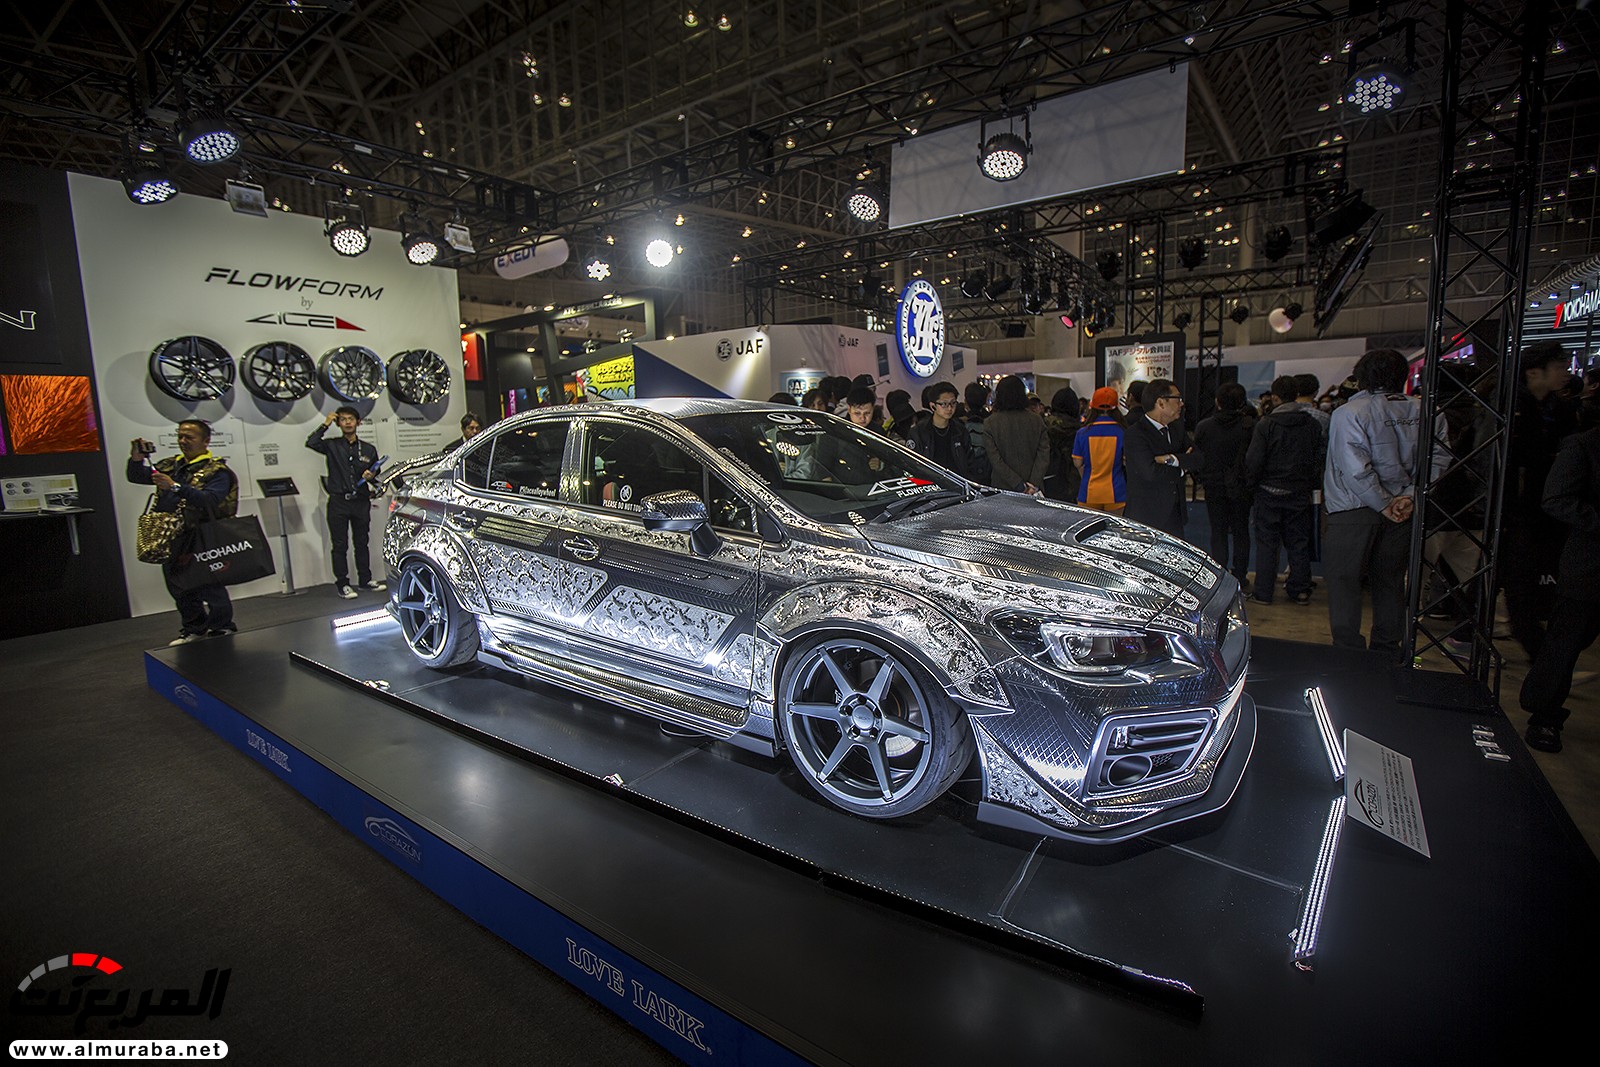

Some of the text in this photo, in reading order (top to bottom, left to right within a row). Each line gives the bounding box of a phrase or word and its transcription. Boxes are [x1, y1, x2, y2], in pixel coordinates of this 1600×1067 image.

[497, 245, 536, 268] EXEDY
[205, 267, 384, 300] FLOWFORM
[301, 296, 313, 310] by
[736, 338, 763, 356] JAF
[847, 337, 859, 347] JAF
[896, 484, 942, 498] FLOWFORM
[603, 499, 617, 509] PLEASE
[194, 540, 253, 562] YOKOHAMA
[566, 937, 625, 998] LOVE
